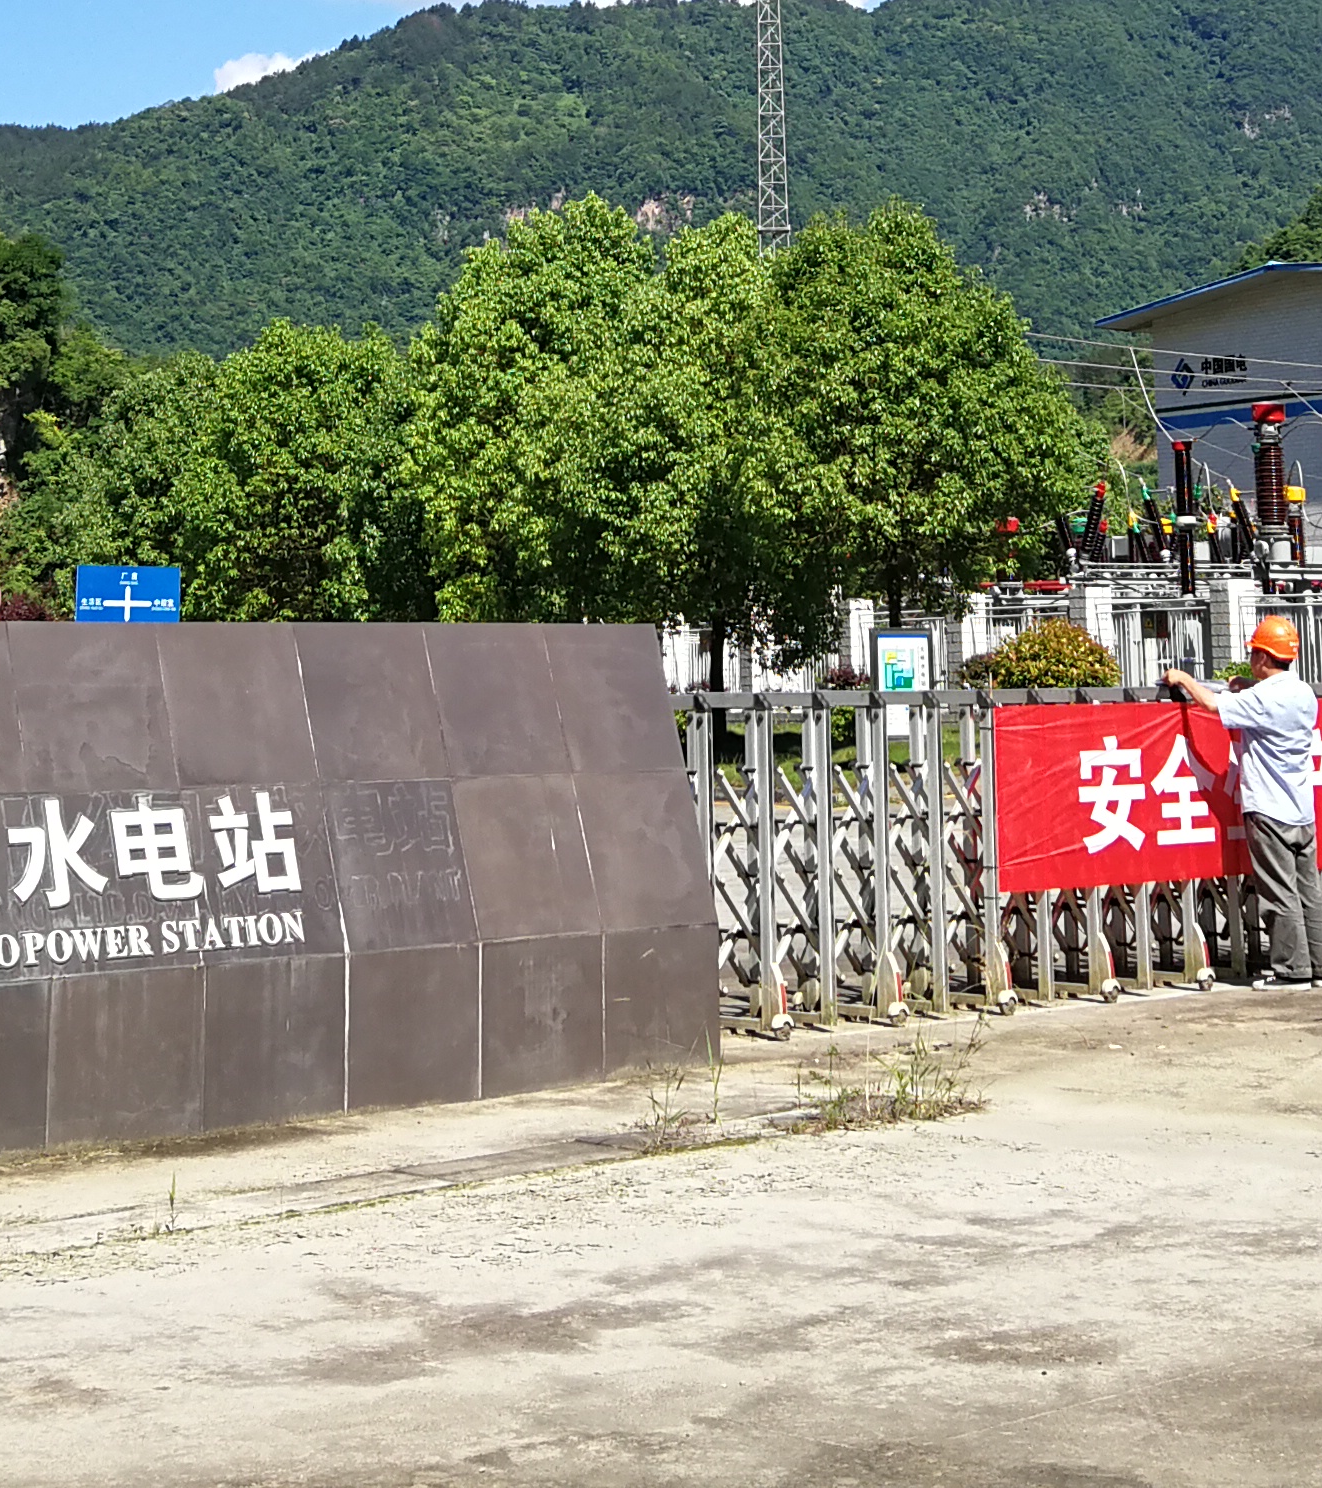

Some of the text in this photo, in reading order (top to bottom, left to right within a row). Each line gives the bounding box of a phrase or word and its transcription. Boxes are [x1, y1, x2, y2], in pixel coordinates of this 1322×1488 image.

[1201, 354, 1248, 374] 中国国电
[159, 910, 307, 954] STATION
